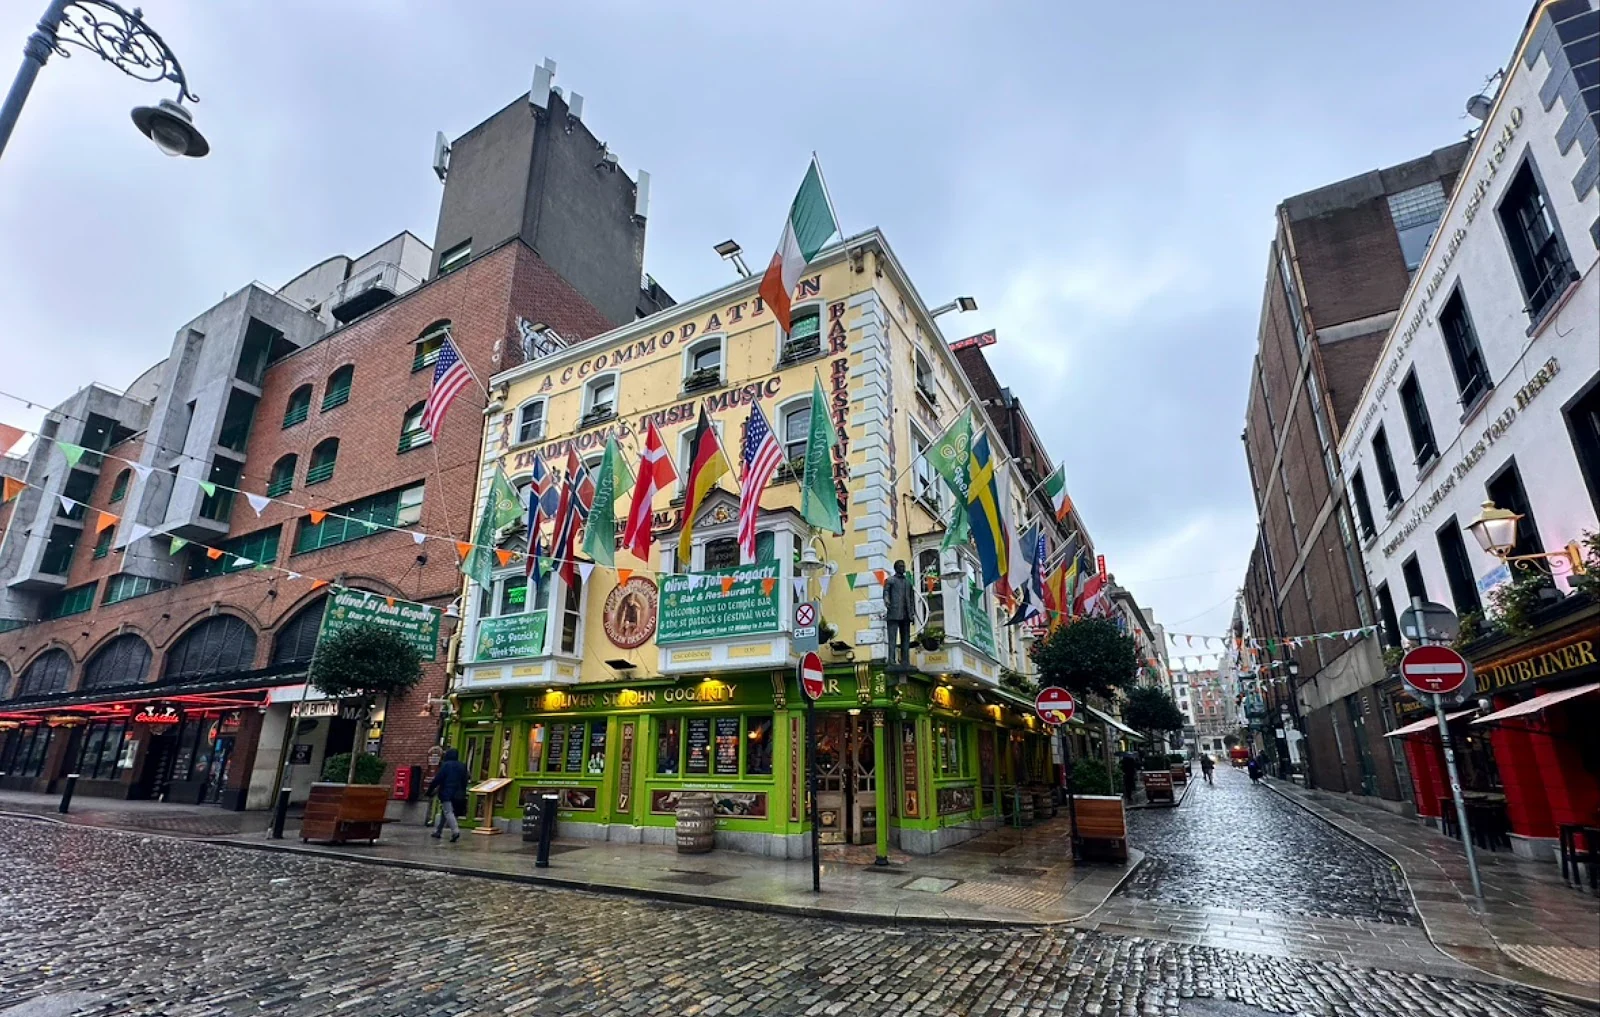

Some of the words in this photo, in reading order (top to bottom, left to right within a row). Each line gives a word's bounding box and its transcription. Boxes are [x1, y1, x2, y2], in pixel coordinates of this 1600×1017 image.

[1484, 106, 1523, 180] 1840
[538, 273, 822, 394] ACCOMMODATIN
[829, 301, 848, 355] BAR
[638, 400, 697, 434] IRISH
[706, 376, 782, 415] MUSIC
[1452, 440, 1487, 481] TALES
[1483, 405, 1517, 447] TOLD
[1513, 355, 1561, 413] HERE
[664, 577, 693, 593] Olive
[733, 565, 776, 585] Gogarty
[680, 594, 696, 604] Bar
[1493, 640, 1597, 688] DUBLINER
[551, 693, 595, 710] OLIVER
[603, 693, 617, 706] ST
[622, 689, 657, 705] JOHN
[664, 683, 737, 702] GOGARTY
